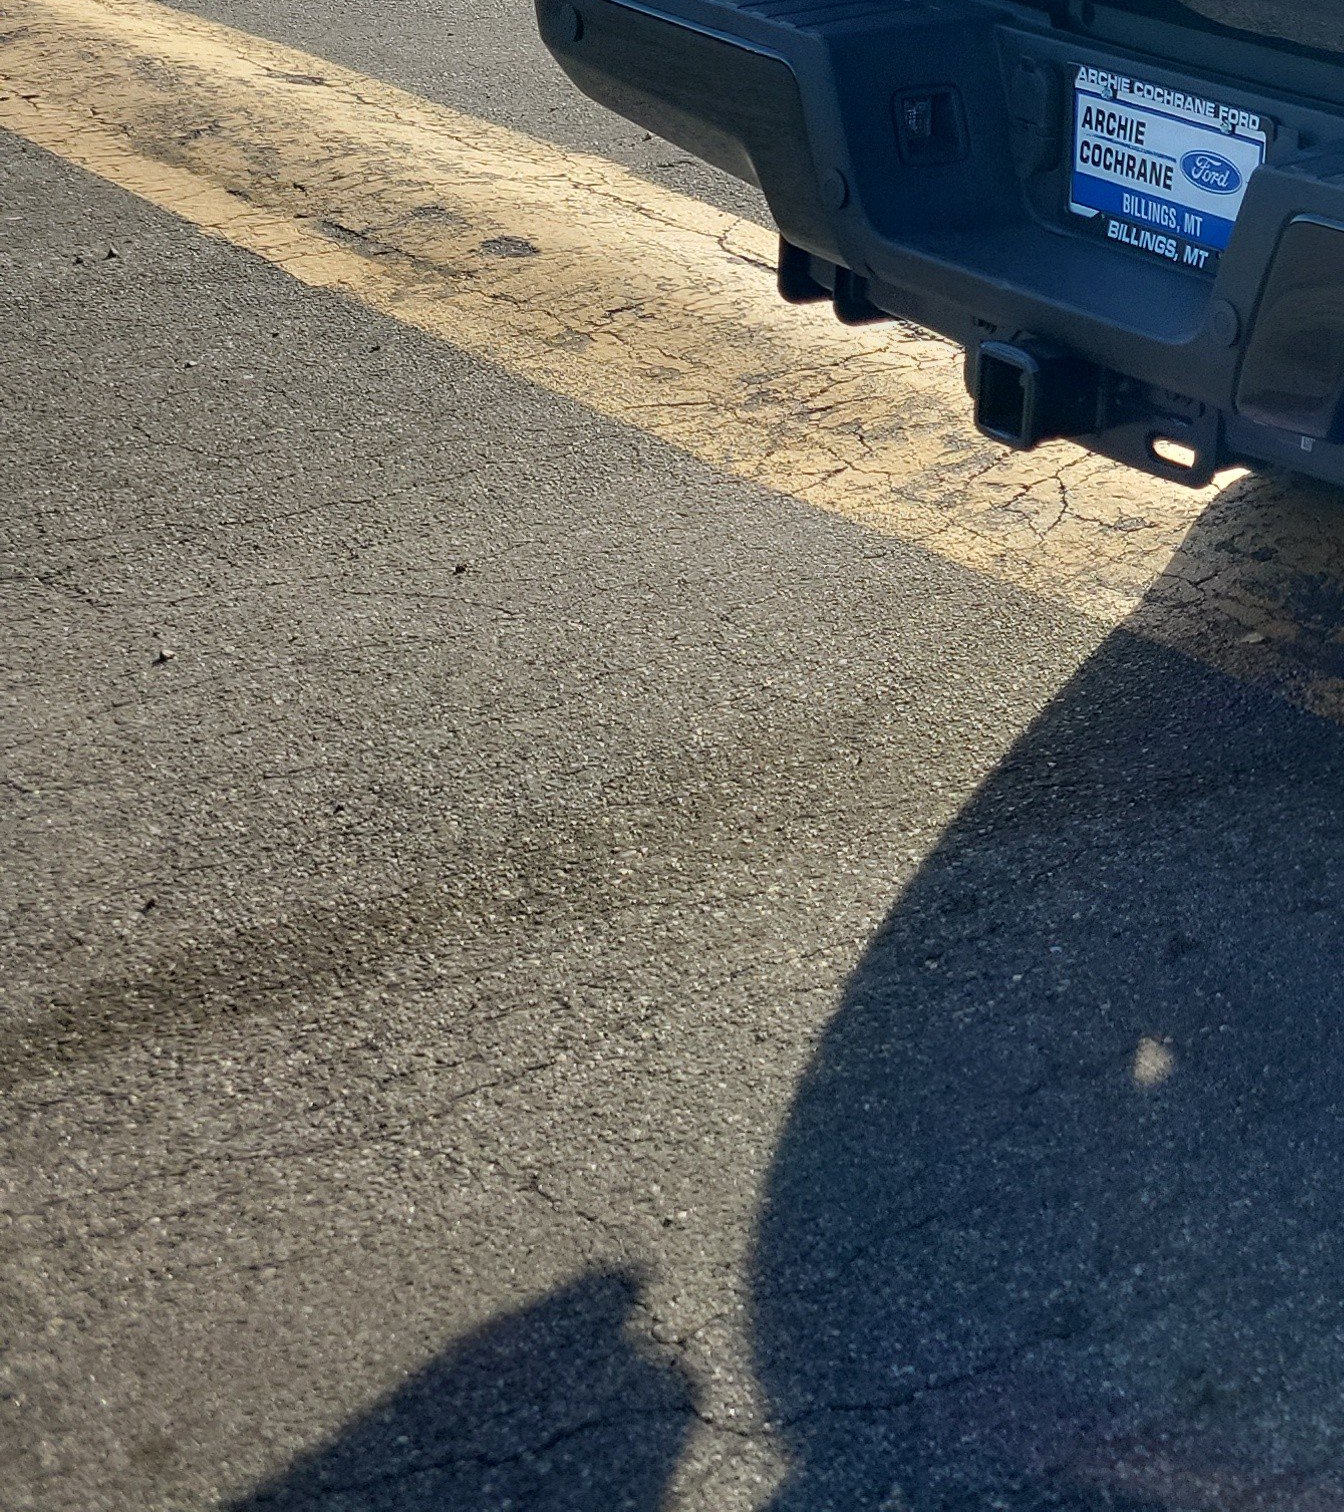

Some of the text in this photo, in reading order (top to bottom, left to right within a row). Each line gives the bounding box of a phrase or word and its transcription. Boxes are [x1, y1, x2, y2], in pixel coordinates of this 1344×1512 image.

[1077, 66, 1260, 130] ARCHIE COCHRANE FORD
[1081, 105, 1147, 146] ARCHIE
[1080, 139, 1175, 191] COCHRANE
[1191, 156, 1230, 188] Ford
[1122, 192, 1203, 237] BILLINGS, MT
[1107, 220, 1209, 269] BILLINGS, MT
